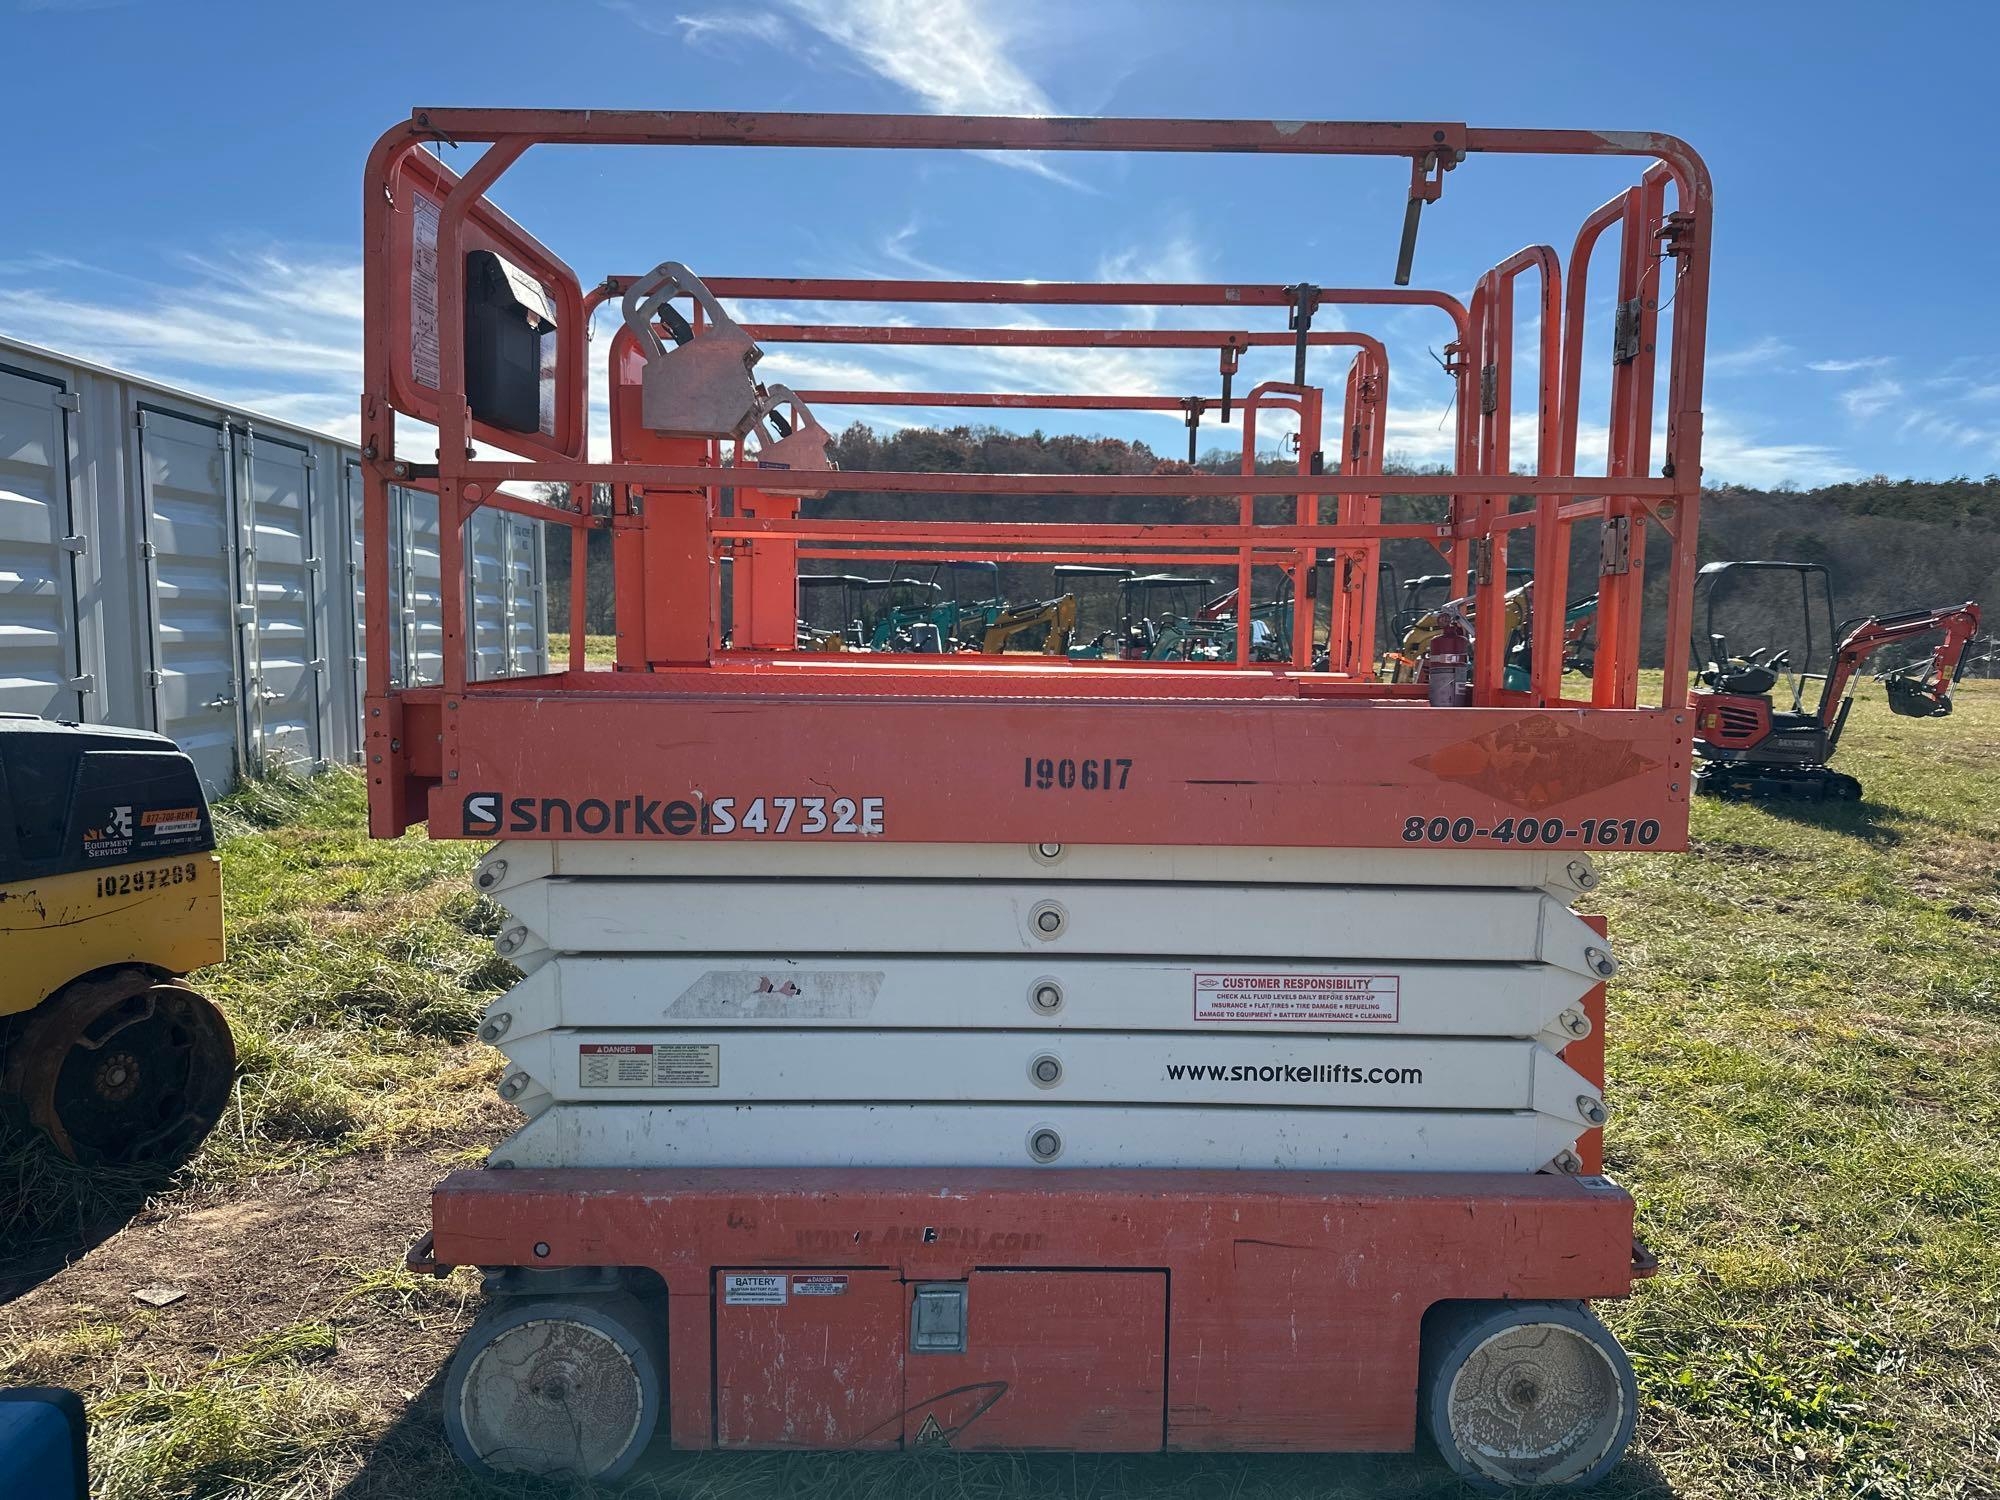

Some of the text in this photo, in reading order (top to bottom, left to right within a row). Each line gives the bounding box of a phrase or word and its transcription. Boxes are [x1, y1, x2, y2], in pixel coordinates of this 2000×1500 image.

[1024, 757, 1133, 791] 190617
[711, 796, 884, 835] S4732E
[1401, 816, 1661, 846] 800-400-1610
[1222, 978, 1371, 990] CUSTOMER RESPONSIBILITY
[603, 1046, 637, 1054] DANGER
[1166, 1064, 1423, 1084] www.snorkellifts.com
[735, 1277, 776, 1286] BATTERY
